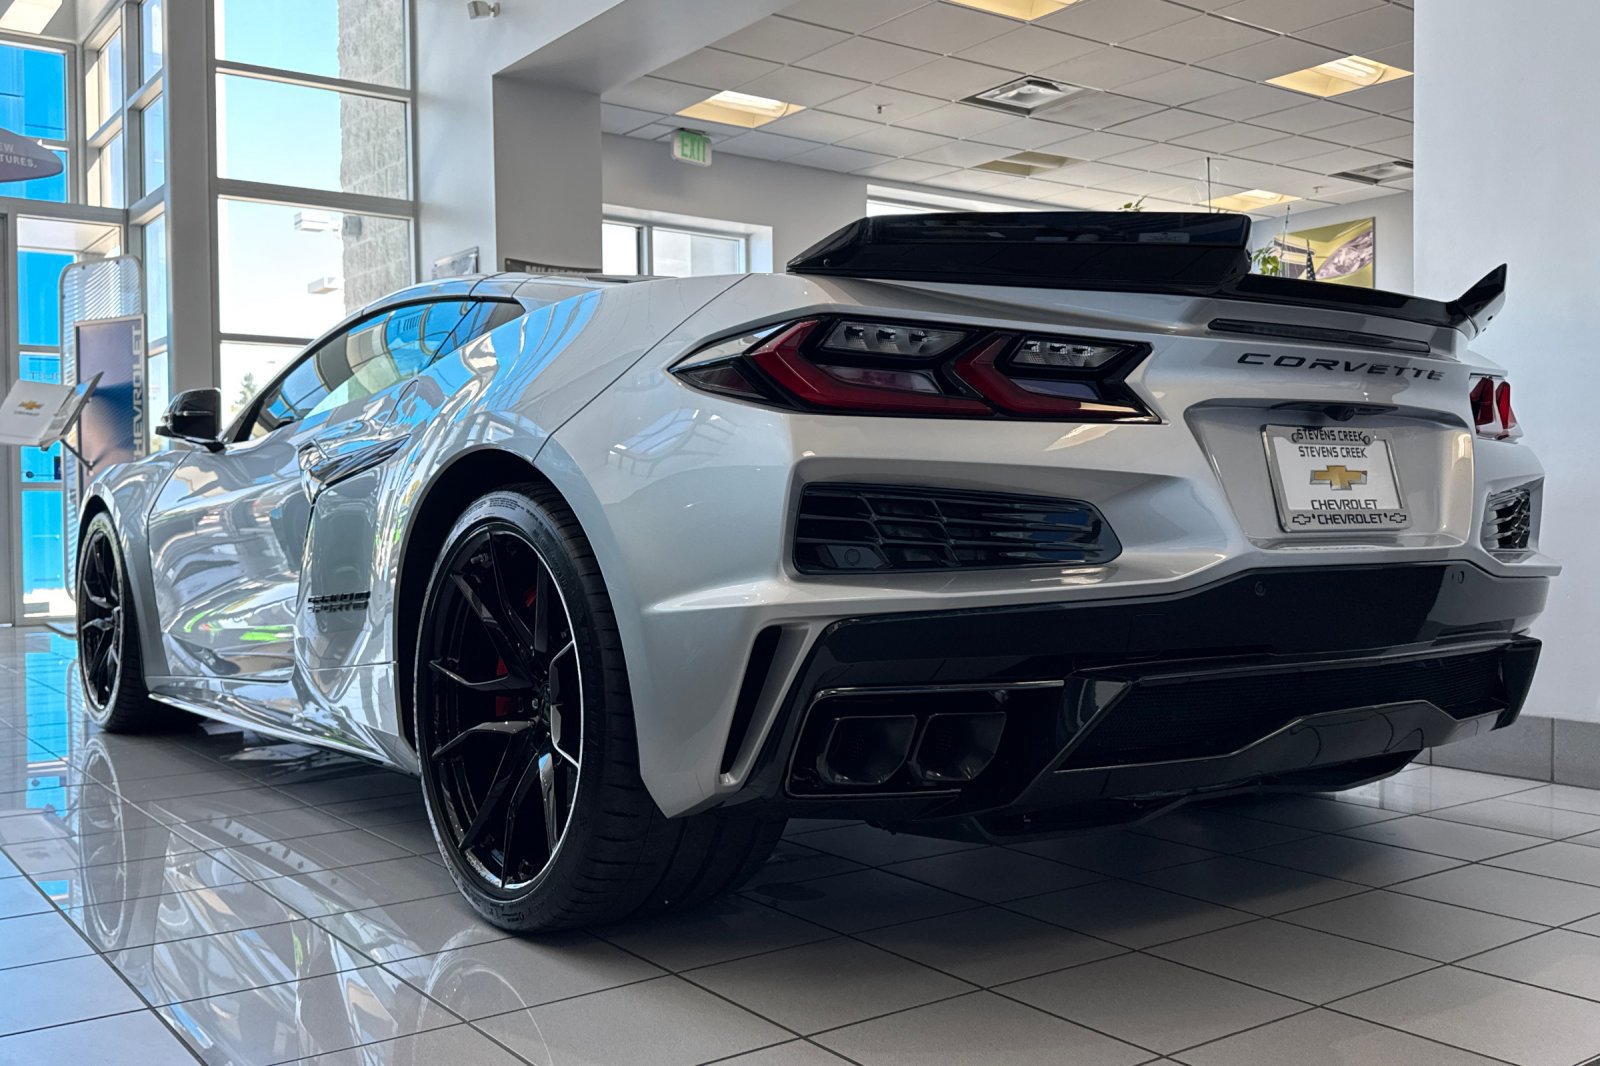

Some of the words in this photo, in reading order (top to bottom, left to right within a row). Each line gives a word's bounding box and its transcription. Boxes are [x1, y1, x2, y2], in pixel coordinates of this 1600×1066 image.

[680, 131, 709, 162] EXIT
[1237, 353, 1445, 381] CORVETTE
[132, 325, 143, 460] HEVROLET
[1296, 429, 1336, 441] STEVENS
[1337, 430, 1364, 442] CREEK
[1299, 446, 1339, 458] STEVENS
[1340, 447, 1368, 459] CREEK
[1311, 500, 1377, 510] CHEVROLET
[1317, 513, 1382, 525] CHEVROLET
